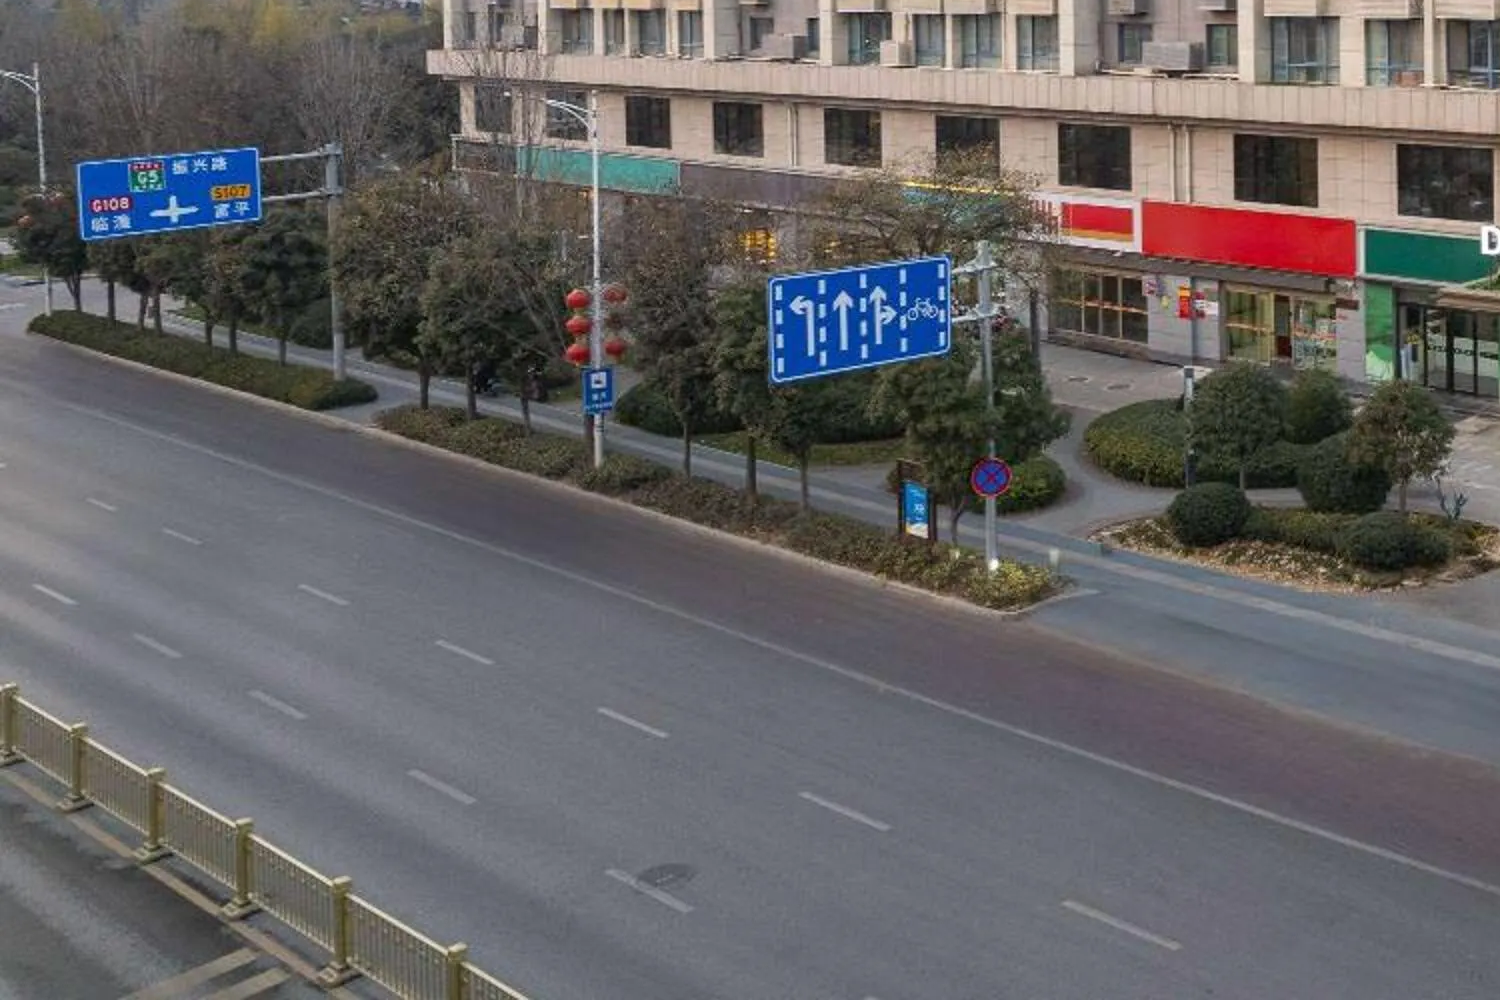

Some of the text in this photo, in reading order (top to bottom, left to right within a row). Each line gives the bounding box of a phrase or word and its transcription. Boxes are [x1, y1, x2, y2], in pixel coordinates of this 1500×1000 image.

[172, 156, 227, 175] 振兴路
[137, 170, 159, 184] G5
[215, 185, 246, 199] S107
[92, 197, 130, 212] G108
